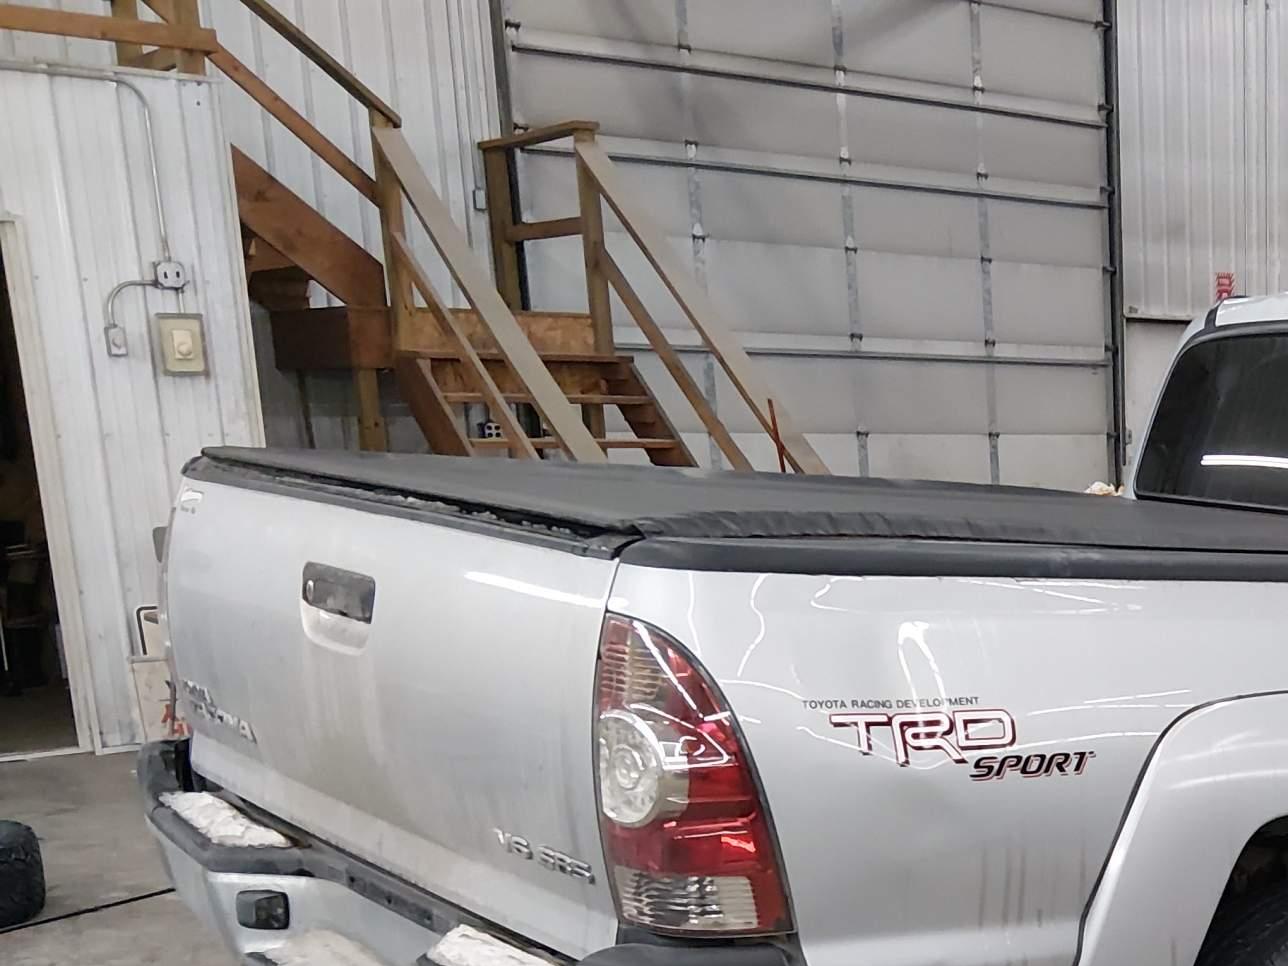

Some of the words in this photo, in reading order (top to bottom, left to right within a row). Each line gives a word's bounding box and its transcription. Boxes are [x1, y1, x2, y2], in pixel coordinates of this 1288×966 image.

[802, 699, 848, 710] TOYOTA
[851, 699, 893, 709] RACING
[829, 708, 1017, 767] TRD
[969, 751, 1096, 782] SPORT
